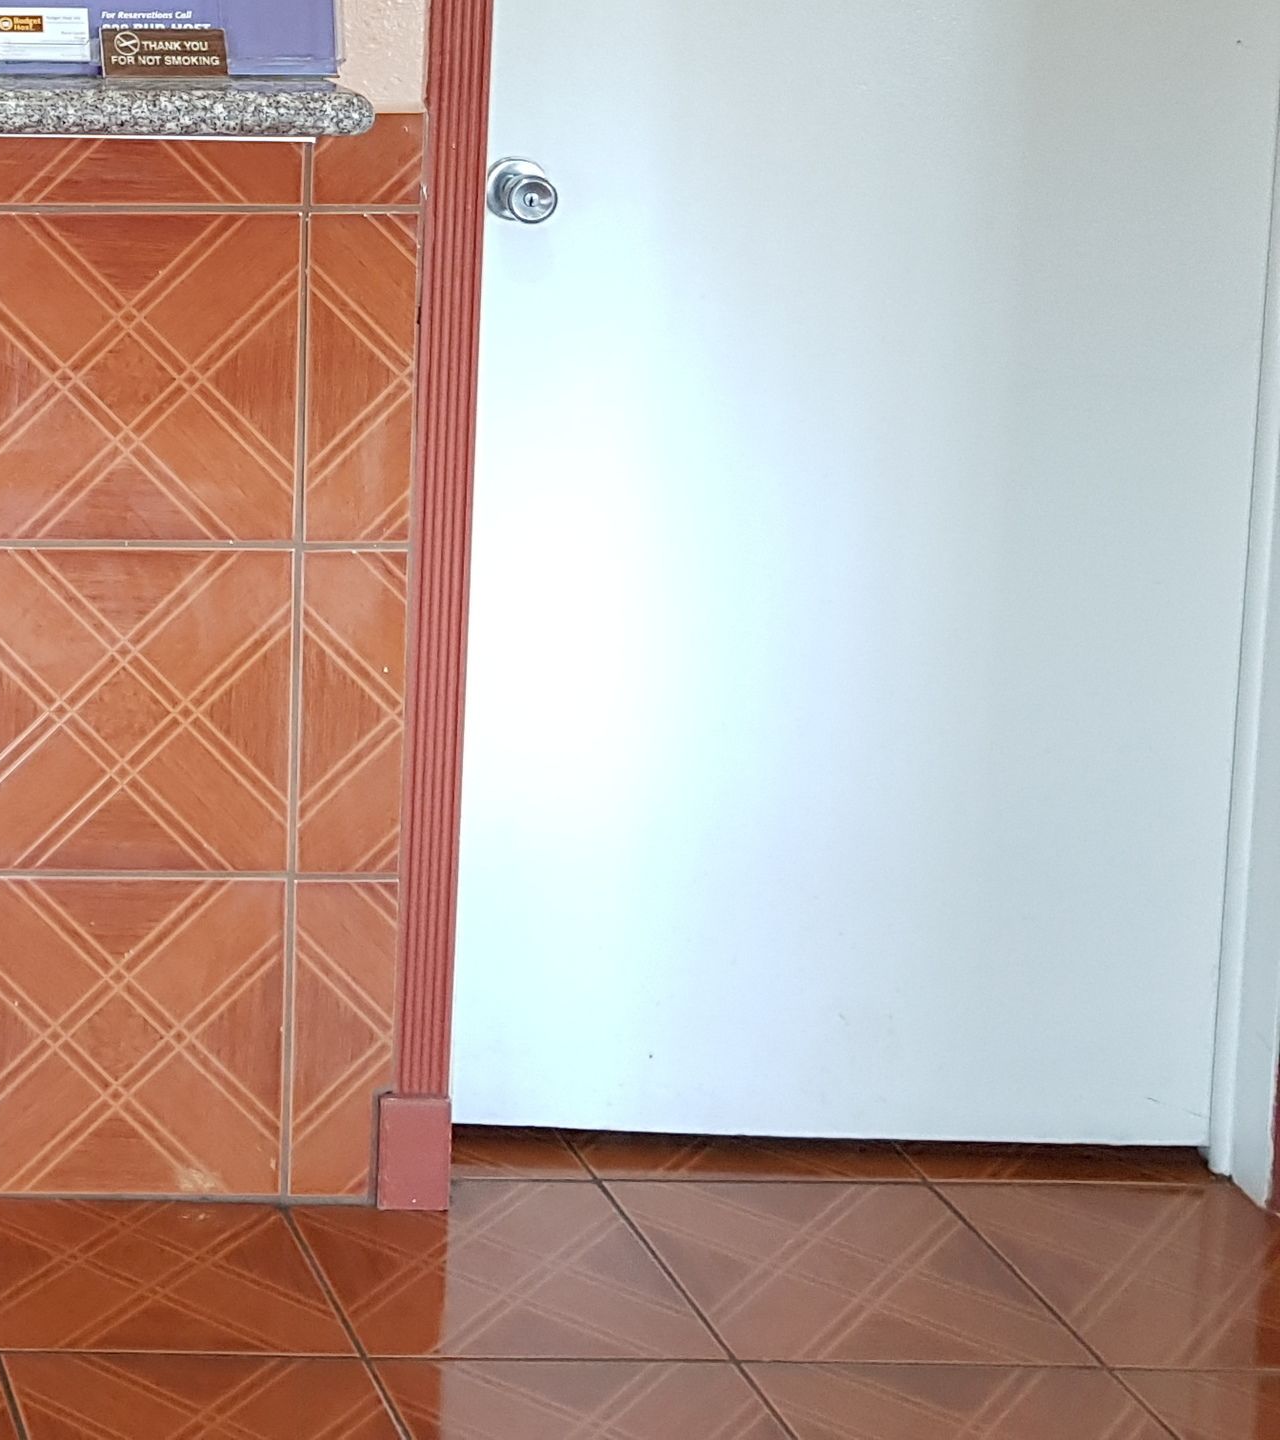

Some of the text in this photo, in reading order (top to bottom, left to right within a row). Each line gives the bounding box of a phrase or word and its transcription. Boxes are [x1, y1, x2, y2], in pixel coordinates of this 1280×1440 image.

[101, 10, 192, 19] For Reservations Call
[142, 40, 209, 51] THANK YOU
[111, 55, 220, 66] FOR NOT SMOKING
